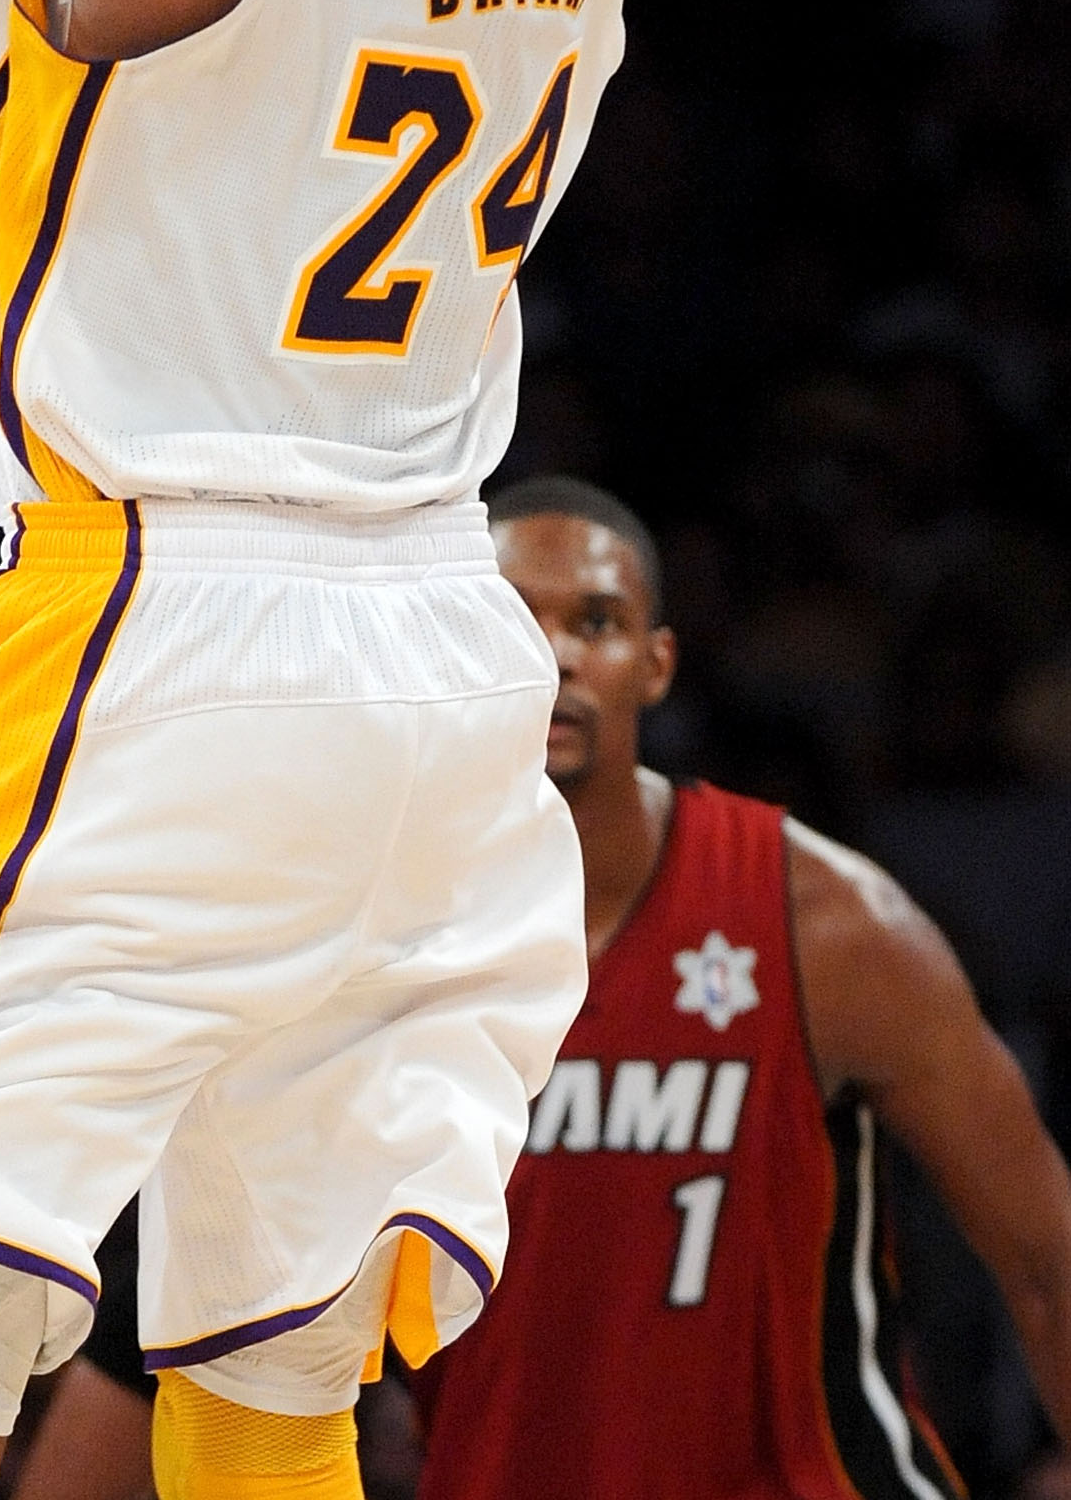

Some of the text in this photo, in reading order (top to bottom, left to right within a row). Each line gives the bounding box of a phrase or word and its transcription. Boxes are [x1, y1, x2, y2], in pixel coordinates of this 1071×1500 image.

[281, 44, 581, 358] 24
[524, 1057, 751, 1155] AMI
[667, 1173, 727, 1307] 1
